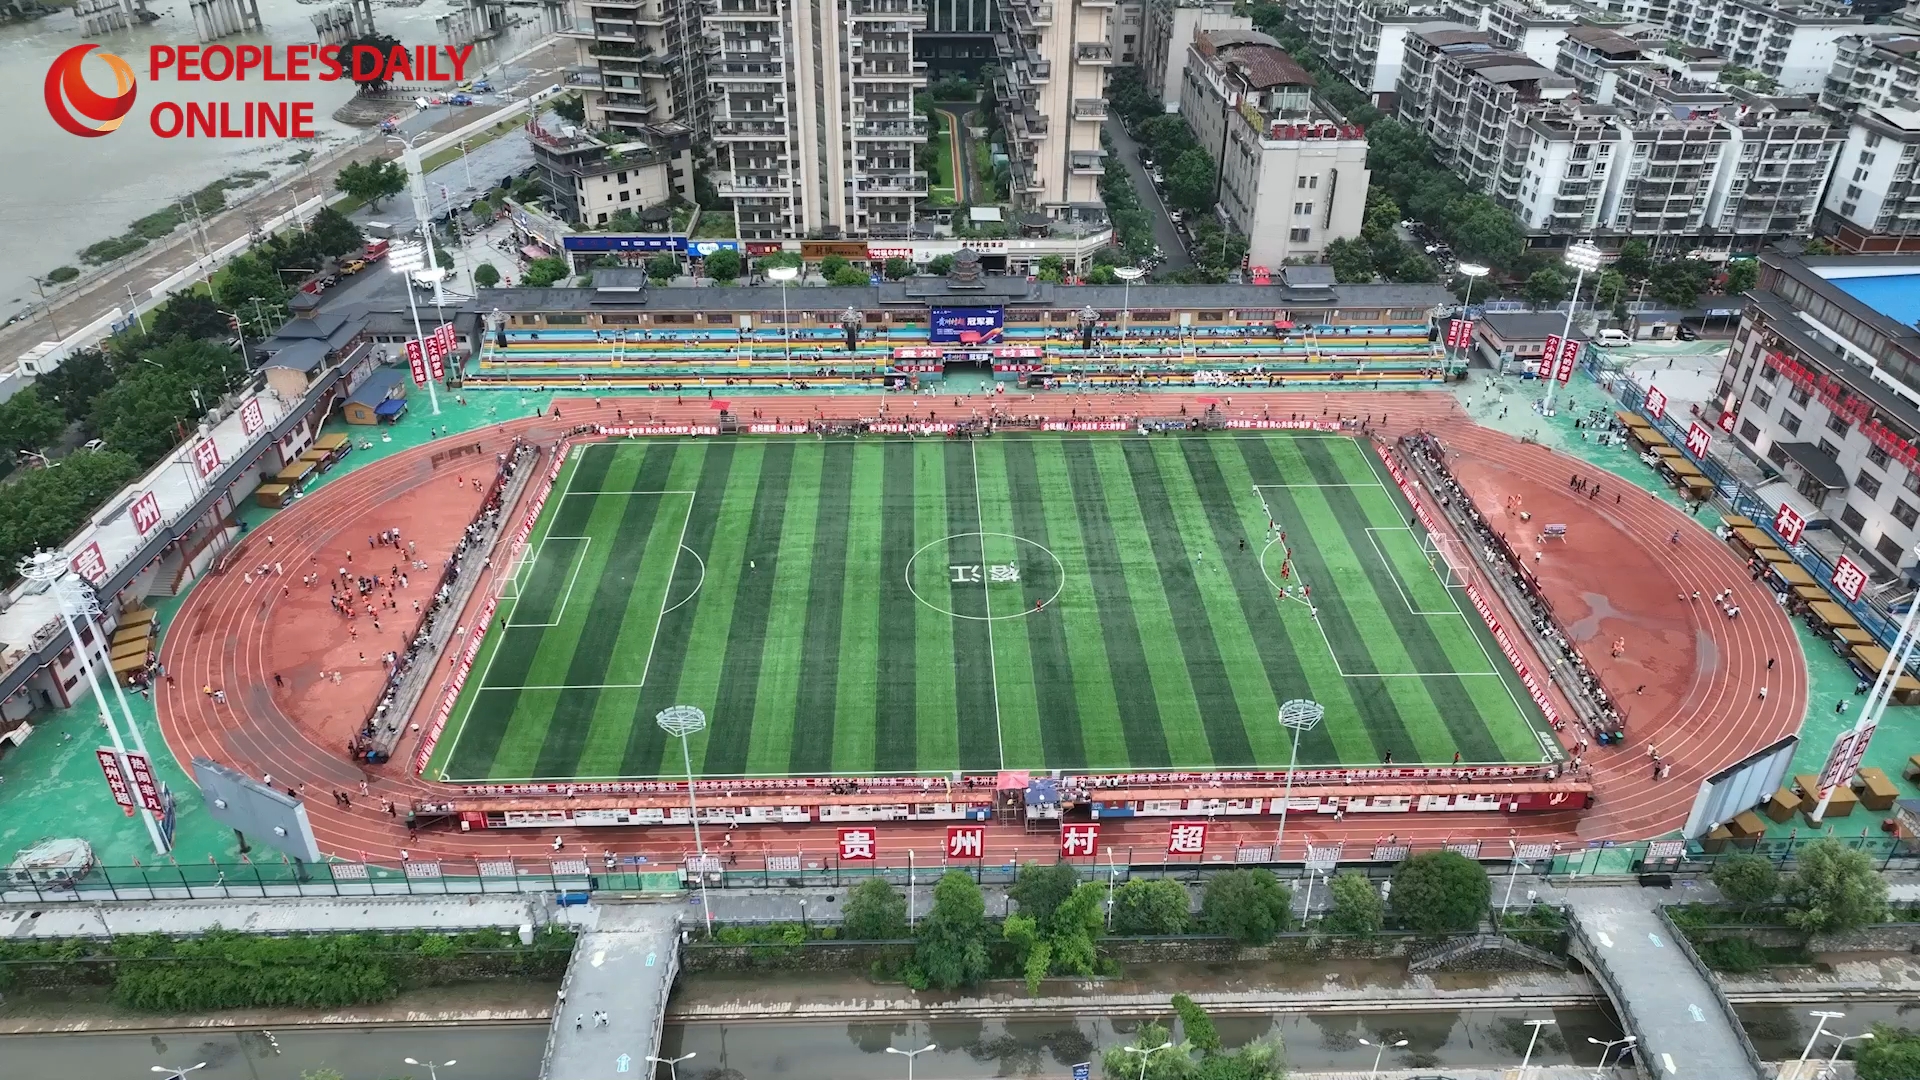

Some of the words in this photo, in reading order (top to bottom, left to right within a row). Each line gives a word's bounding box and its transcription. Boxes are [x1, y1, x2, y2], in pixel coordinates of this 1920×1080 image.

[967, 316, 995, 326] 冠军赛
[408, 343, 426, 382] 小小的足球
[427, 340, 444, 378] 大大的梦想
[1541, 337, 1558, 376] 小小的足球
[1558, 342, 1577, 382] 大大的梦想
[76, 550, 103, 582] 贵
[137, 500, 160, 531] 州
[197, 439, 219, 474] 村
[243, 402, 263, 433] 超
[1646, 389, 1664, 418] 贵
[1687, 428, 1708, 459] 州
[1777, 507, 1802, 543] 村
[1832, 560, 1864, 601] 超
[948, 564, 1021, 583] 榕江
[99, 753, 133, 806] 贵州村超
[130, 757, 162, 810] 热闹非凡
[840, 830, 875, 858] 贵
[950, 829, 982, 857] 州
[1063, 827, 1098, 854] 村
[1168, 826, 1203, 853] 超
